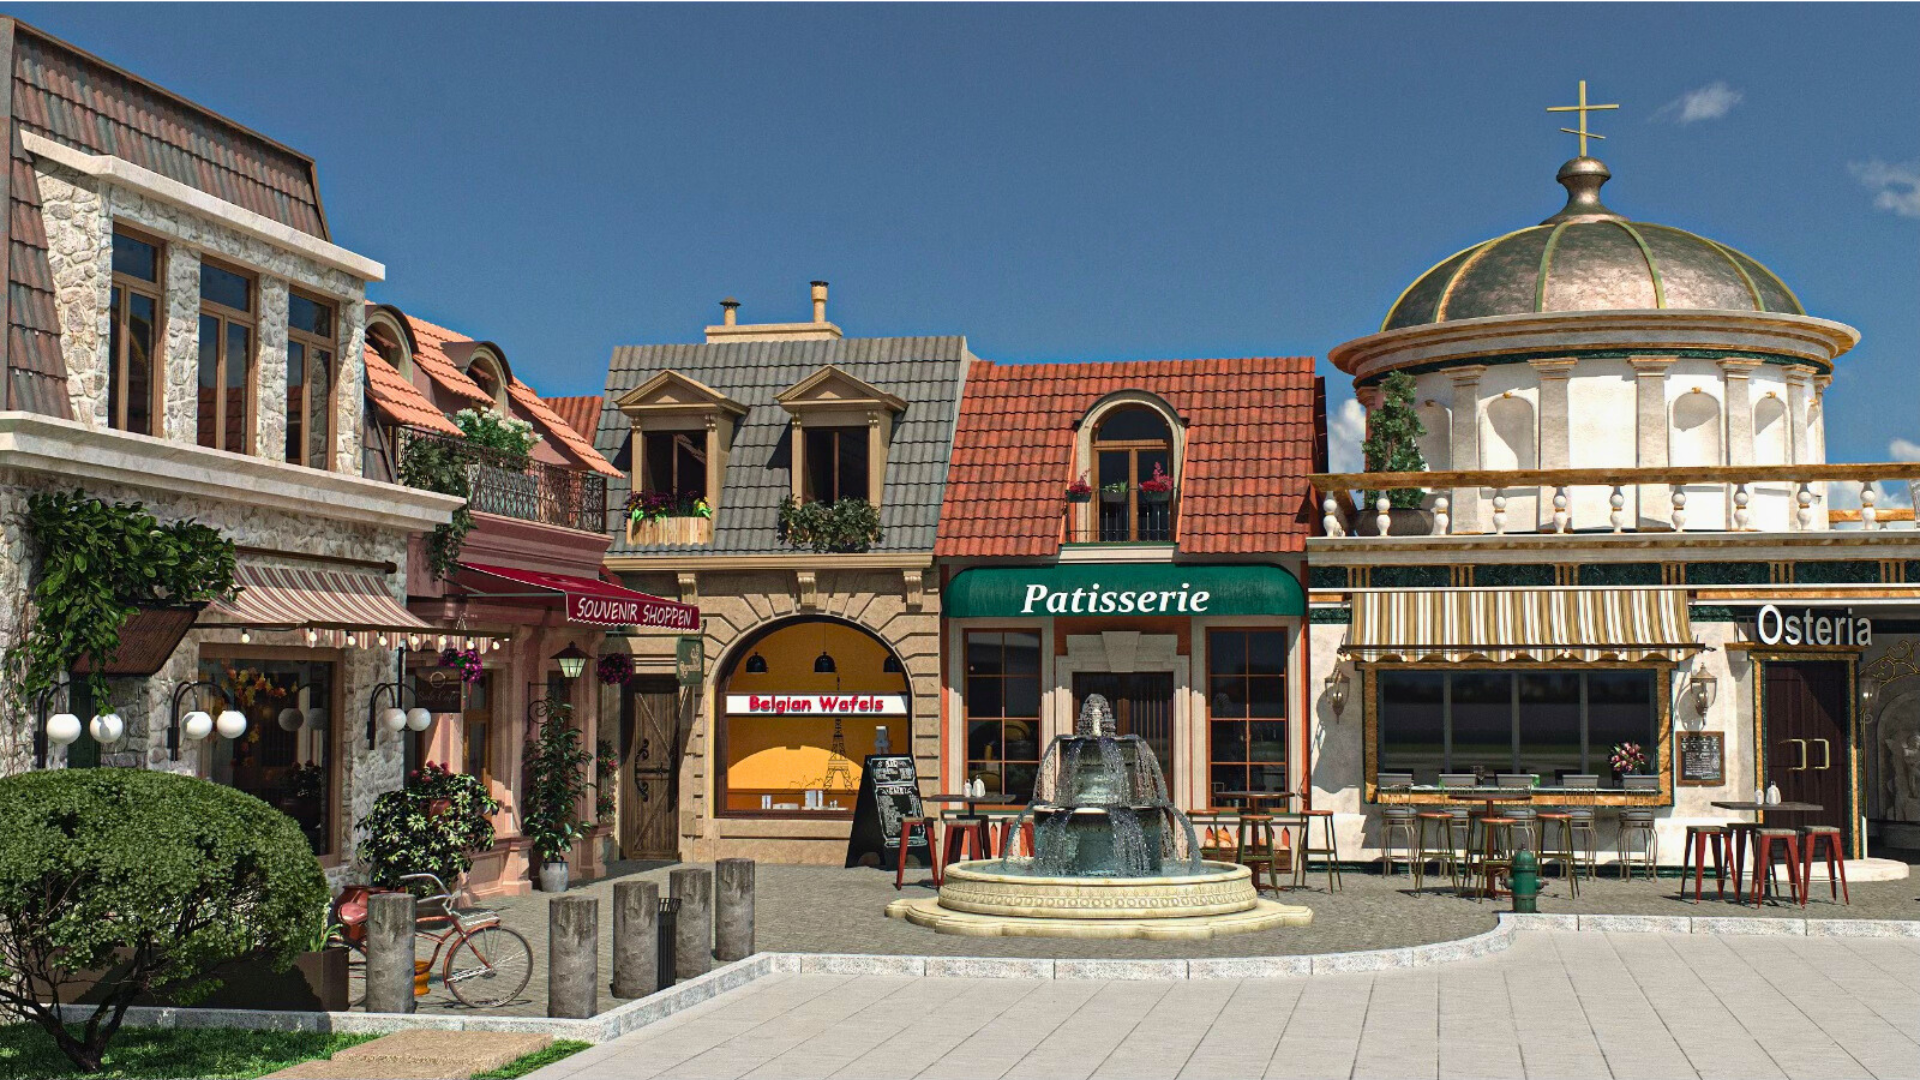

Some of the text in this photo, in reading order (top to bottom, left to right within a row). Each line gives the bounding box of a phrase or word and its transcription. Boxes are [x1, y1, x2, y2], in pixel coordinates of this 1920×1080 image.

[576, 597, 692, 626] SOUVENIR SHOPPEN
[1020, 582, 1211, 613] Patisserie
[1758, 604, 1872, 646] Osteria
[749, 694, 884, 715] Belgian Wafels
